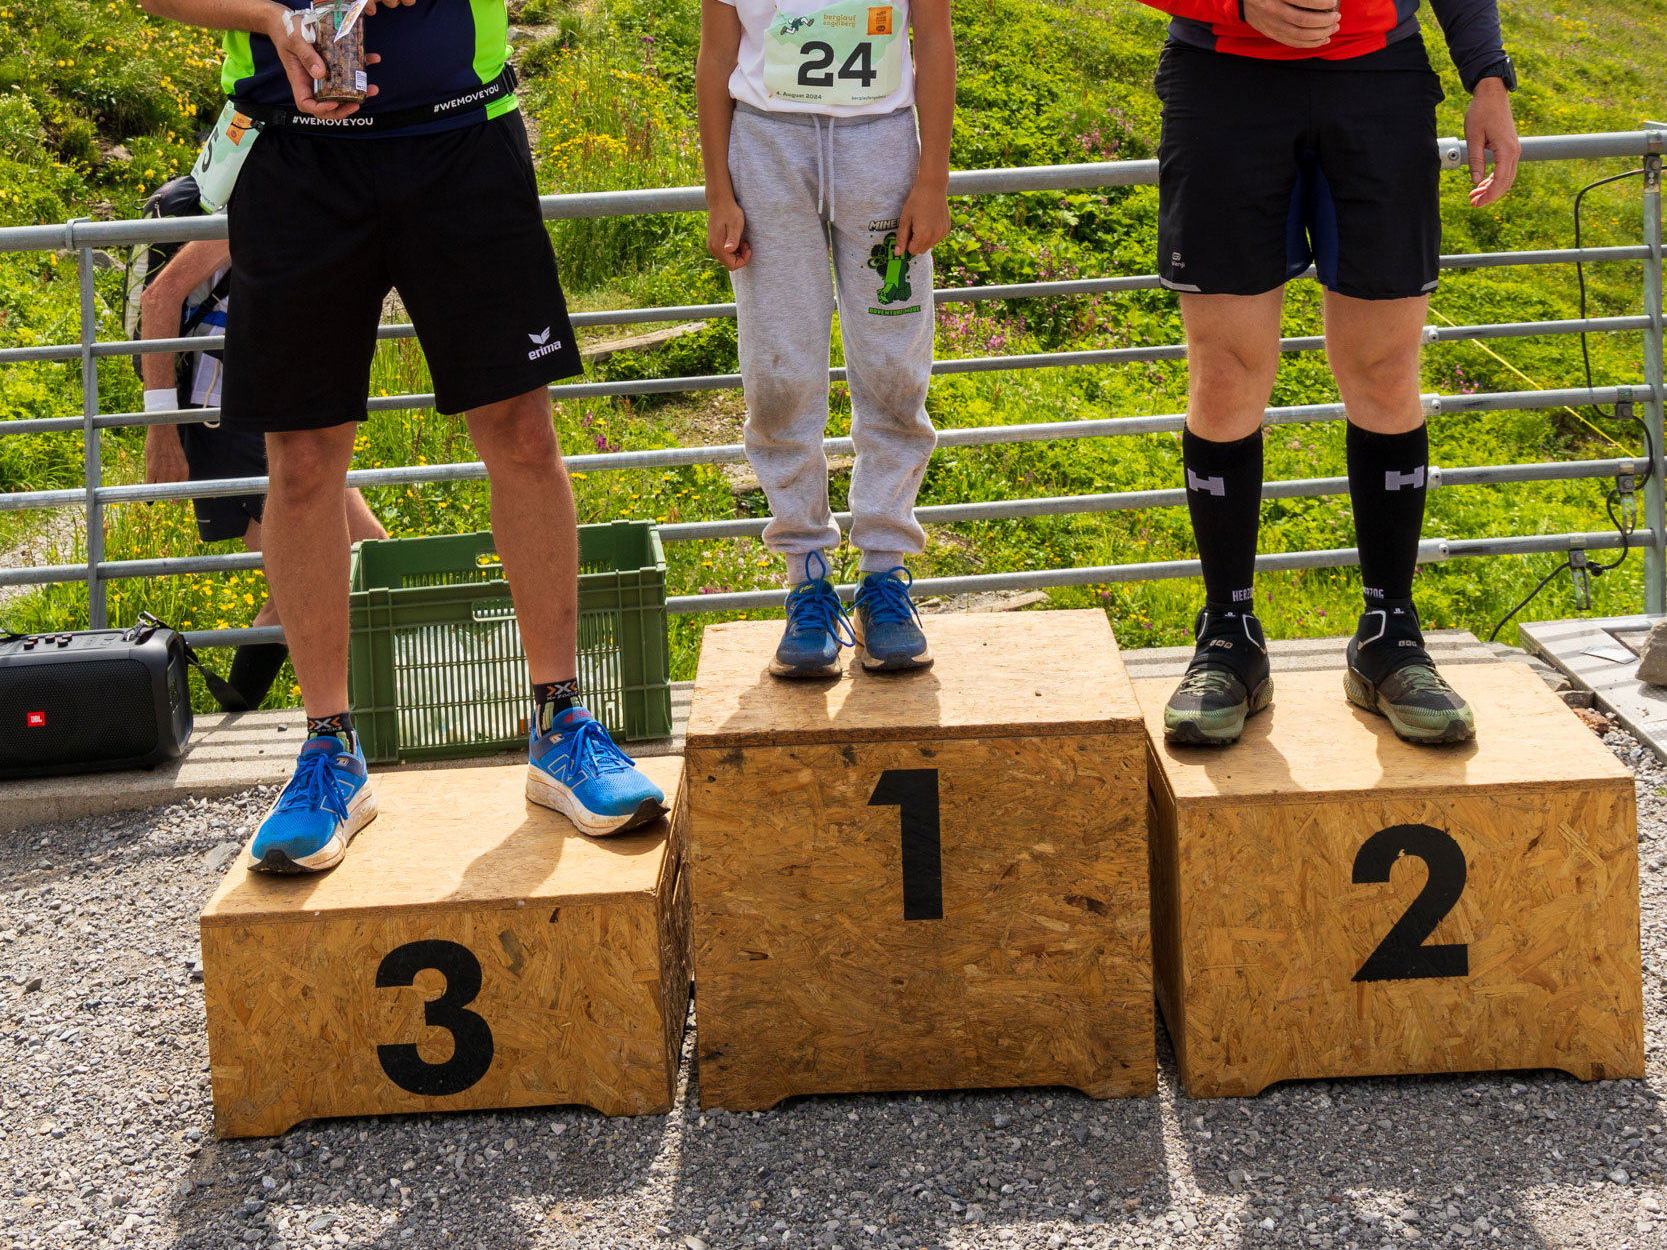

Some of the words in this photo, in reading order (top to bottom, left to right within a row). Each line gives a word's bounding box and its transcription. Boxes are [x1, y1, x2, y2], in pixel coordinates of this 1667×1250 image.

[823, 13, 857, 22] berglauf
[823, 20, 856, 29] engelberg
[797, 40, 877, 88] 24
[433, 83, 499, 113] #WEMOVEYOU
[782, 91, 805, 99] August
[292, 115, 374, 127] #WEMOVEYOU
[868, 218, 900, 231] MINE
[528, 340, 562, 361] erima
[30, 715, 43, 723] JBL
[867, 768, 944, 921] 1
[1351, 823, 1469, 983] 2
[375, 939, 495, 1097] 3
